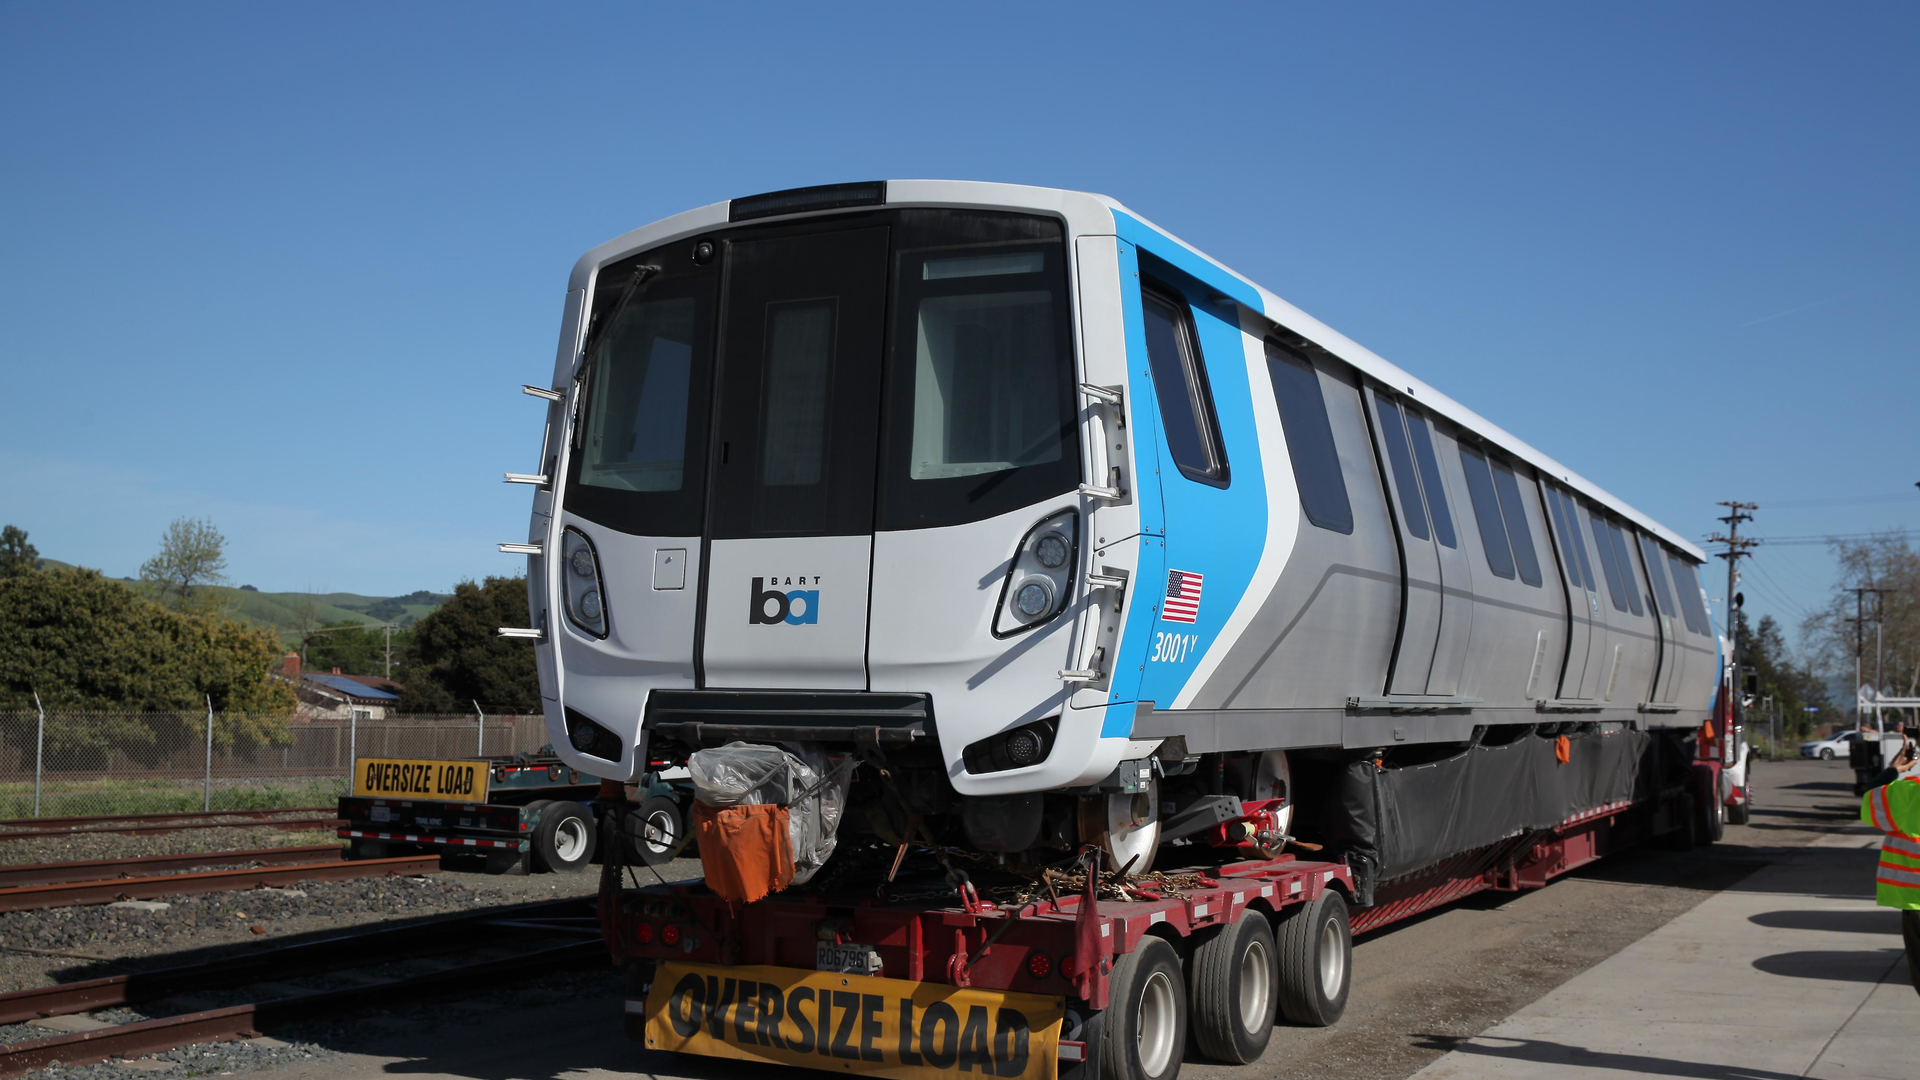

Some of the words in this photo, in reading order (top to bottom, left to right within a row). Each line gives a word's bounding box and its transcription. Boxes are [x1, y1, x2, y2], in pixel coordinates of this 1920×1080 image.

[771, 576, 820, 585] BART
[366, 762, 432, 793] OVERSIZE
[437, 765, 474, 795] LOAD
[818, 947, 868, 969] RD6796
[669, 972, 884, 1063] OVERSIZE
[898, 997, 1029, 1078] LOAD
